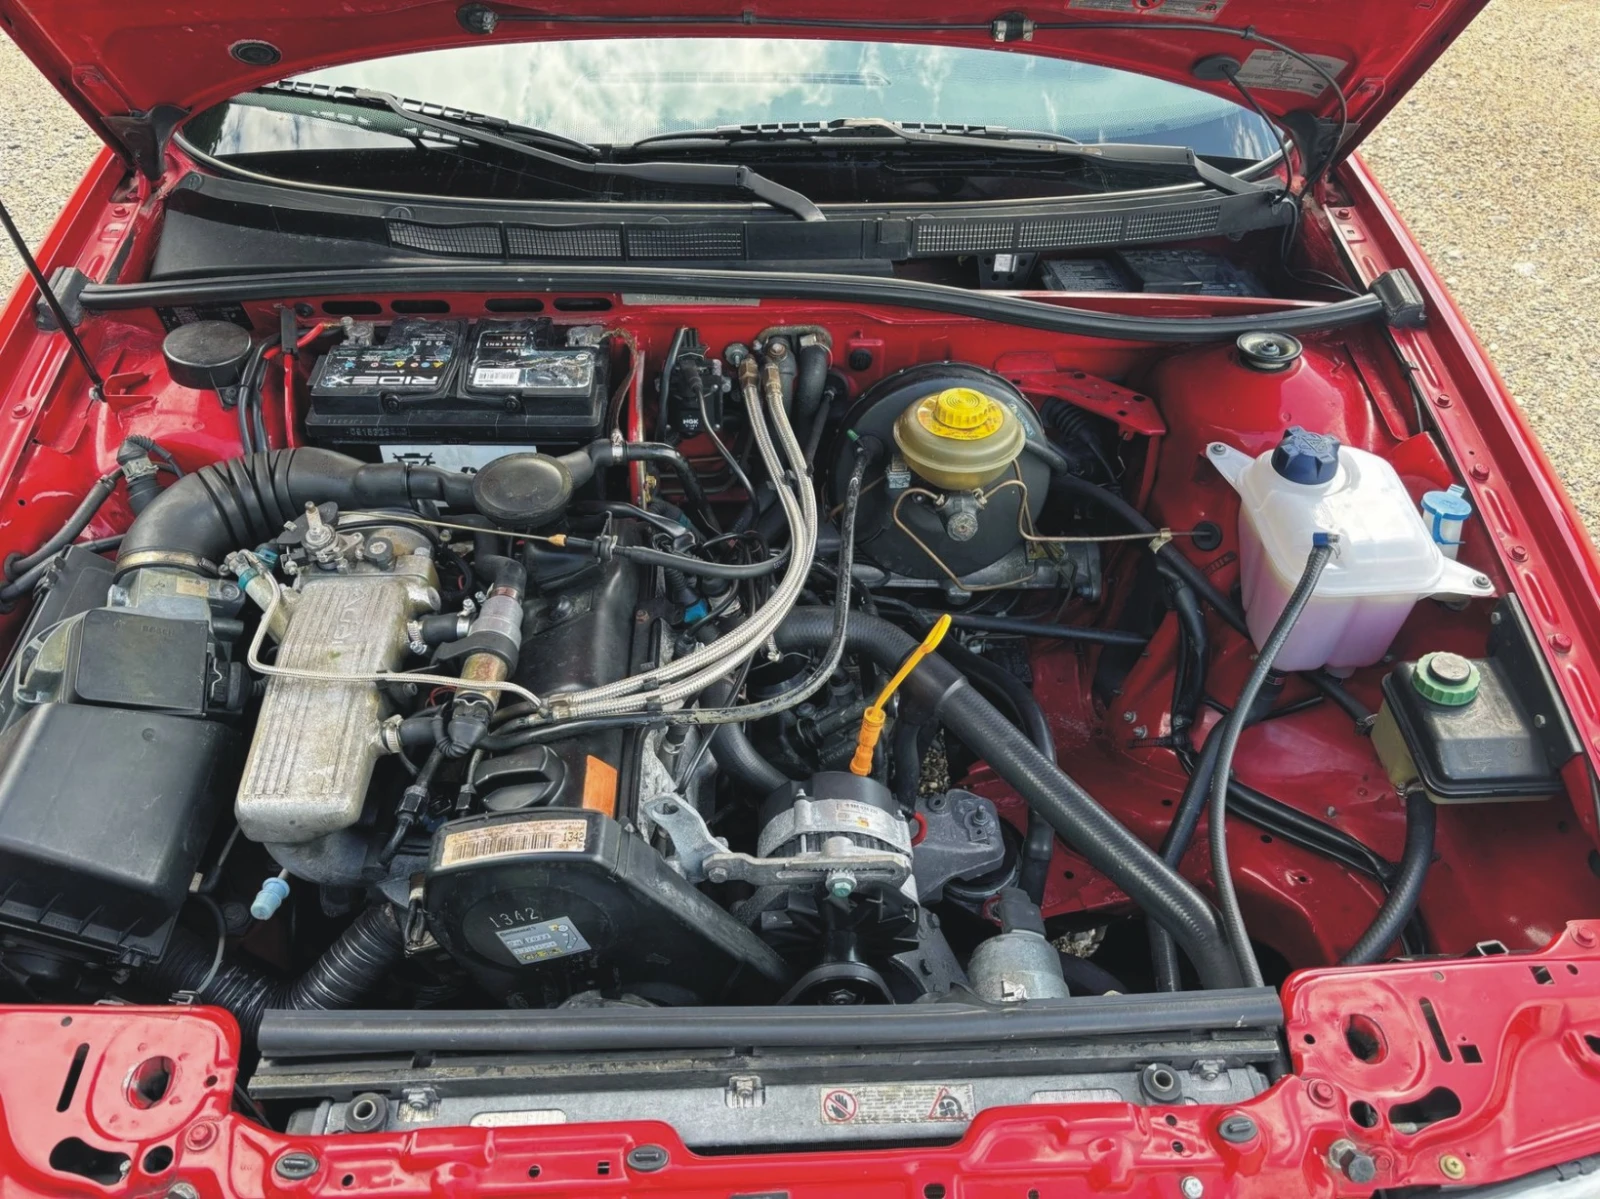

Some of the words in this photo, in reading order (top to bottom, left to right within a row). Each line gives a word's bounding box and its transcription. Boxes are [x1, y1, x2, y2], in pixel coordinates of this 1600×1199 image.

[330, 375, 438, 386] RIDEX
[562, 831, 585, 842] 1342
[489, 907, 539, 928] 1342
